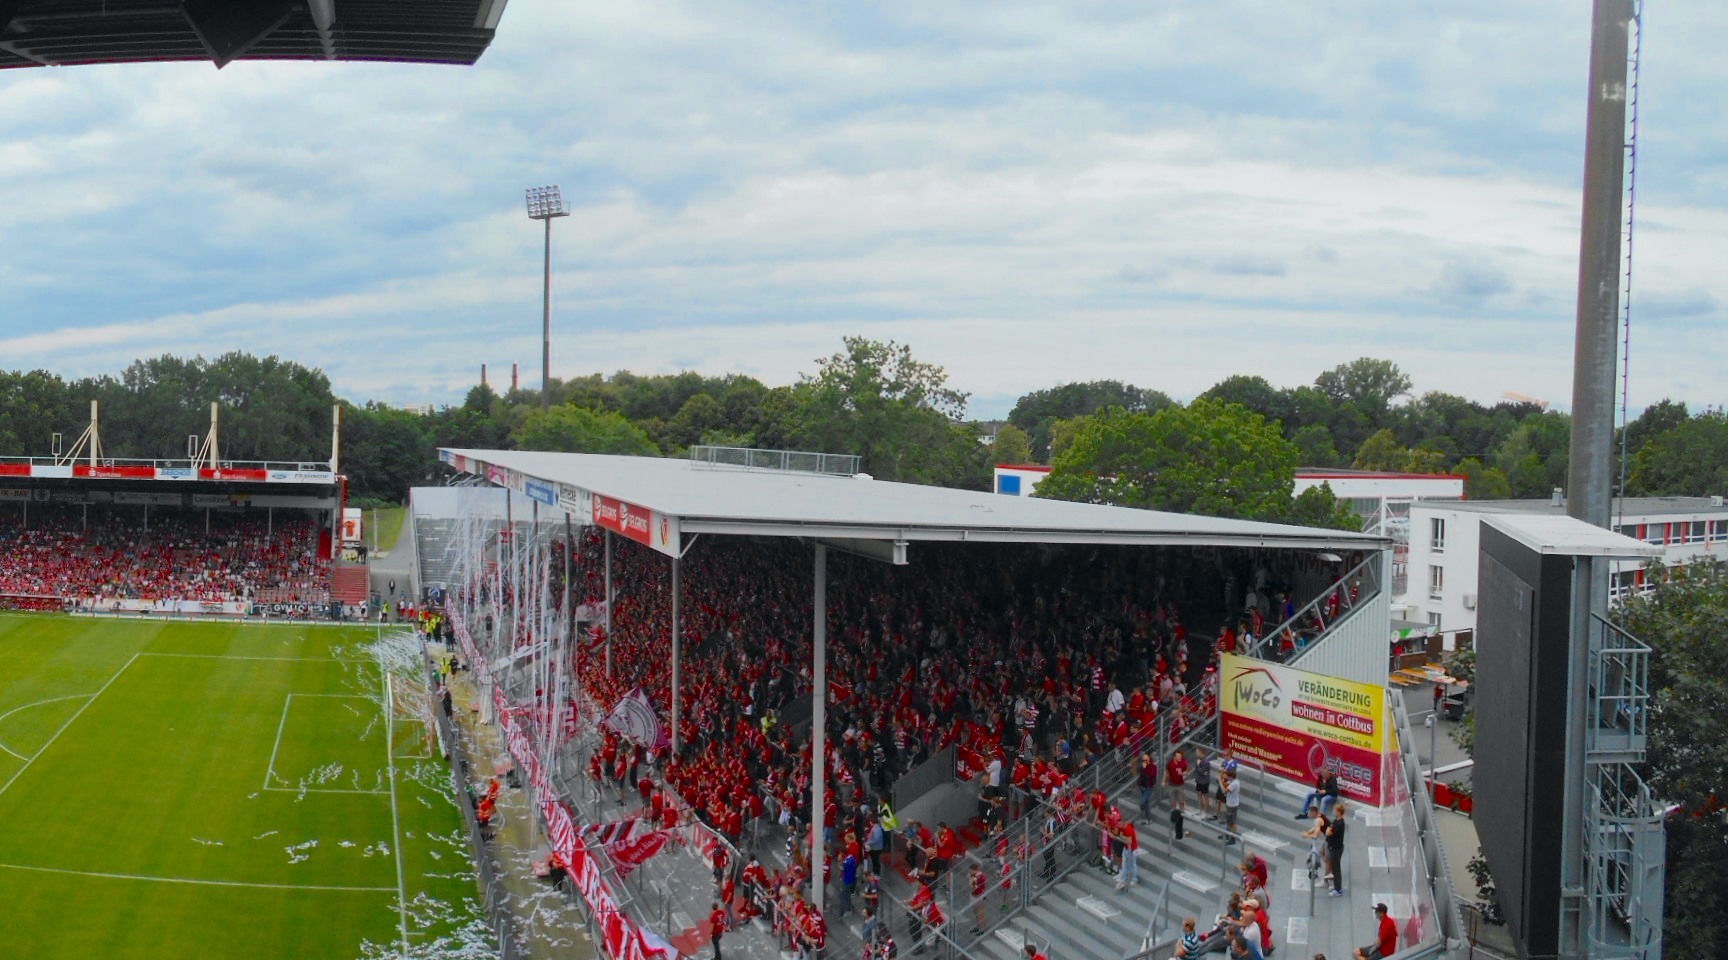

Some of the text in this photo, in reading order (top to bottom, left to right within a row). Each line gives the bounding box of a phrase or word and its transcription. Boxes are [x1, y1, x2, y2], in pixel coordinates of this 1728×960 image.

[97, 471, 121, 479] Sparkasse
[628, 514, 648, 534] SELGROS
[274, 604, 292, 612] GYM
[1298, 679, 1372, 708] VERÄNDERUNG
[1293, 704, 1373, 734] wohnen in Cottbus
[1307, 726, 1372, 749] www.woco-cottbus.de
[1336, 776, 1371, 794] dlerpension
